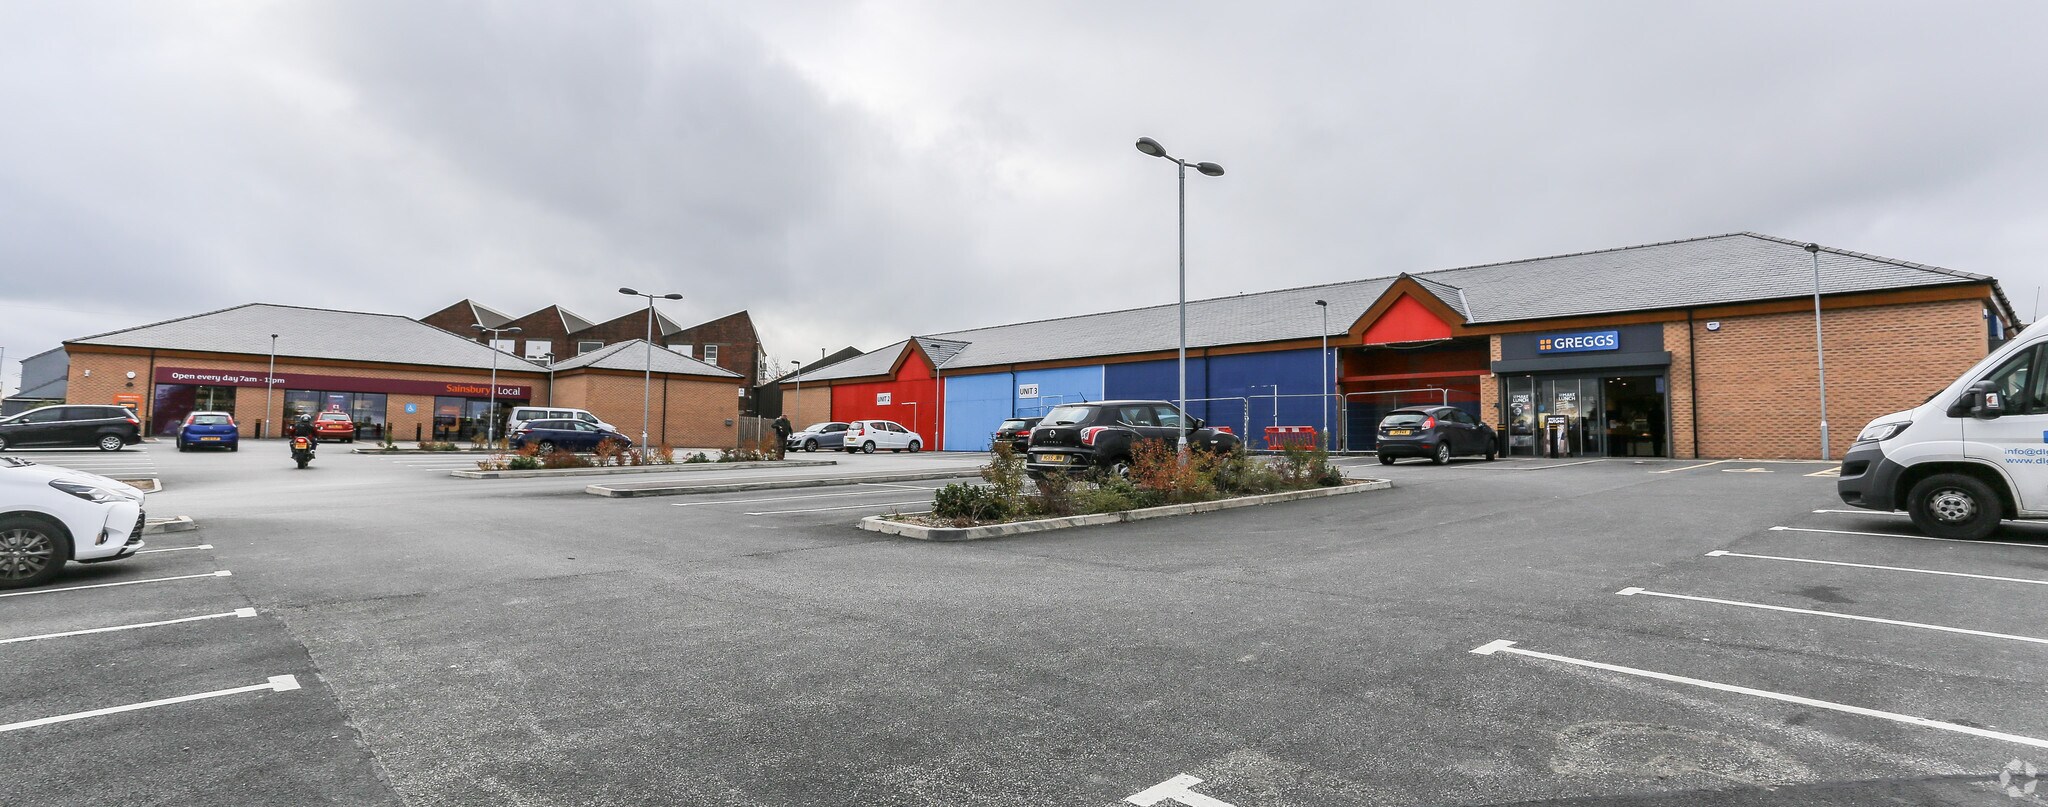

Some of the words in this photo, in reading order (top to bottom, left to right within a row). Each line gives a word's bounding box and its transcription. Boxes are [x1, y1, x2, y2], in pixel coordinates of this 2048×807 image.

[1554, 335, 1614, 349] GREGGS
[172, 372, 195, 380] Open
[196, 374, 221, 382] every
[222, 374, 238, 383] day
[498, 387, 520, 395] Local
[1020, 387, 1033, 395] UNIT
[1034, 387, 1038, 395] 3
